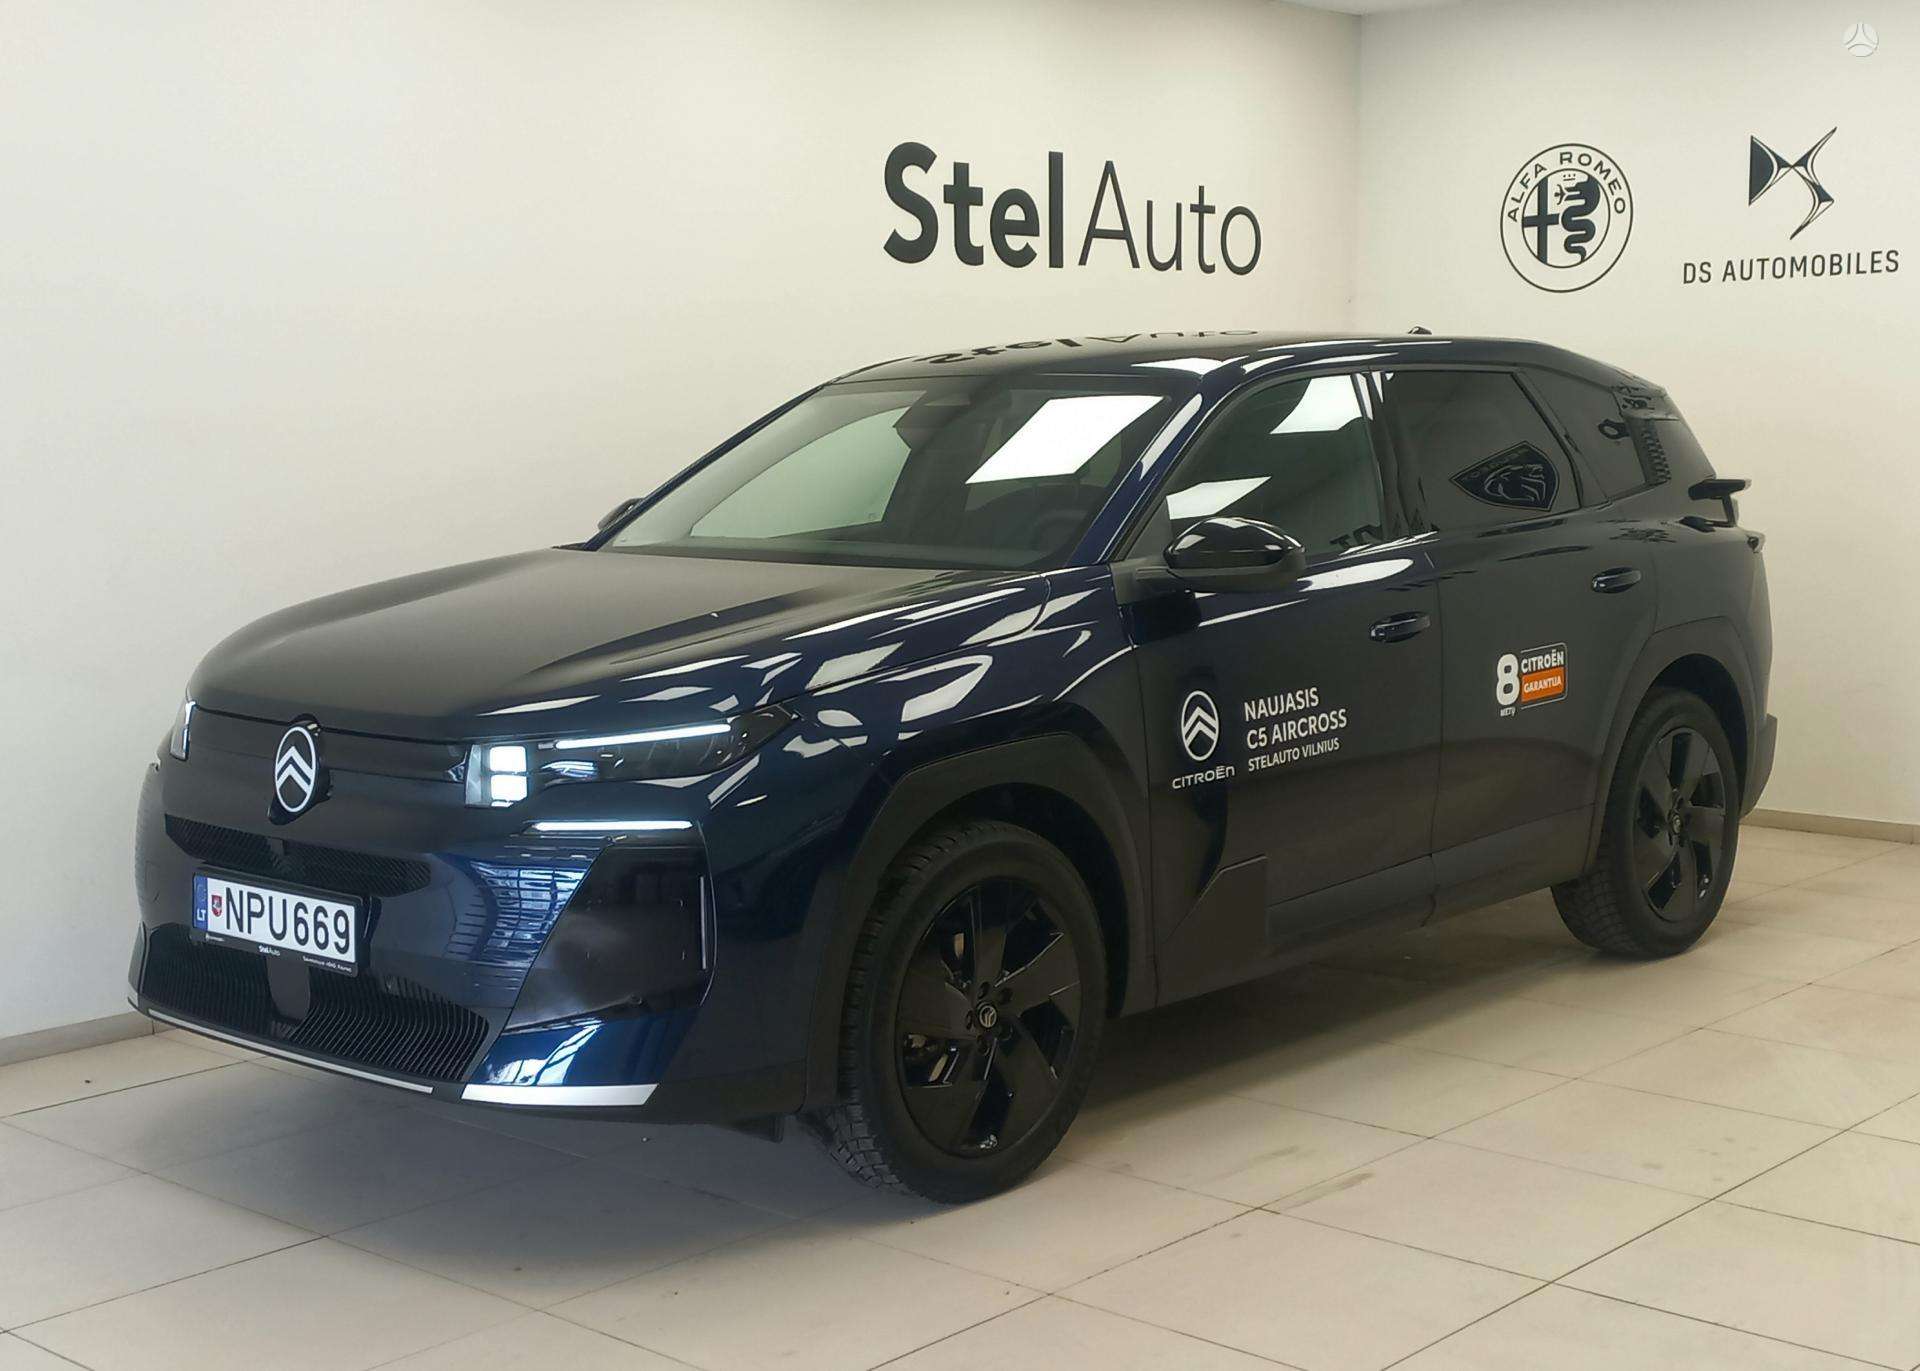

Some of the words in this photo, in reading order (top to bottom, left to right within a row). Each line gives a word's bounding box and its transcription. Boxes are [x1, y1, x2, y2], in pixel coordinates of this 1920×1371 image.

[1507, 163, 1547, 223] ALFA
[1559, 151, 1626, 215] ROMEO
[1683, 262, 1712, 285] DS
[1722, 250, 1900, 283] AUTOMOBILES
[1521, 648, 1564, 674] CITROËN
[1496, 653, 1520, 706] 8
[1524, 675, 1562, 694] GARANTIJA
[1244, 686, 1319, 722] NAUJASIS
[1247, 729, 1268, 750] C5
[1271, 708, 1347, 745] AIRCROSS
[1248, 747, 1300, 772] STELAUTO
[1303, 737, 1340, 758] VILNIUS
[196, 908, 206, 921] LT
[225, 887, 350, 955] NPU669
